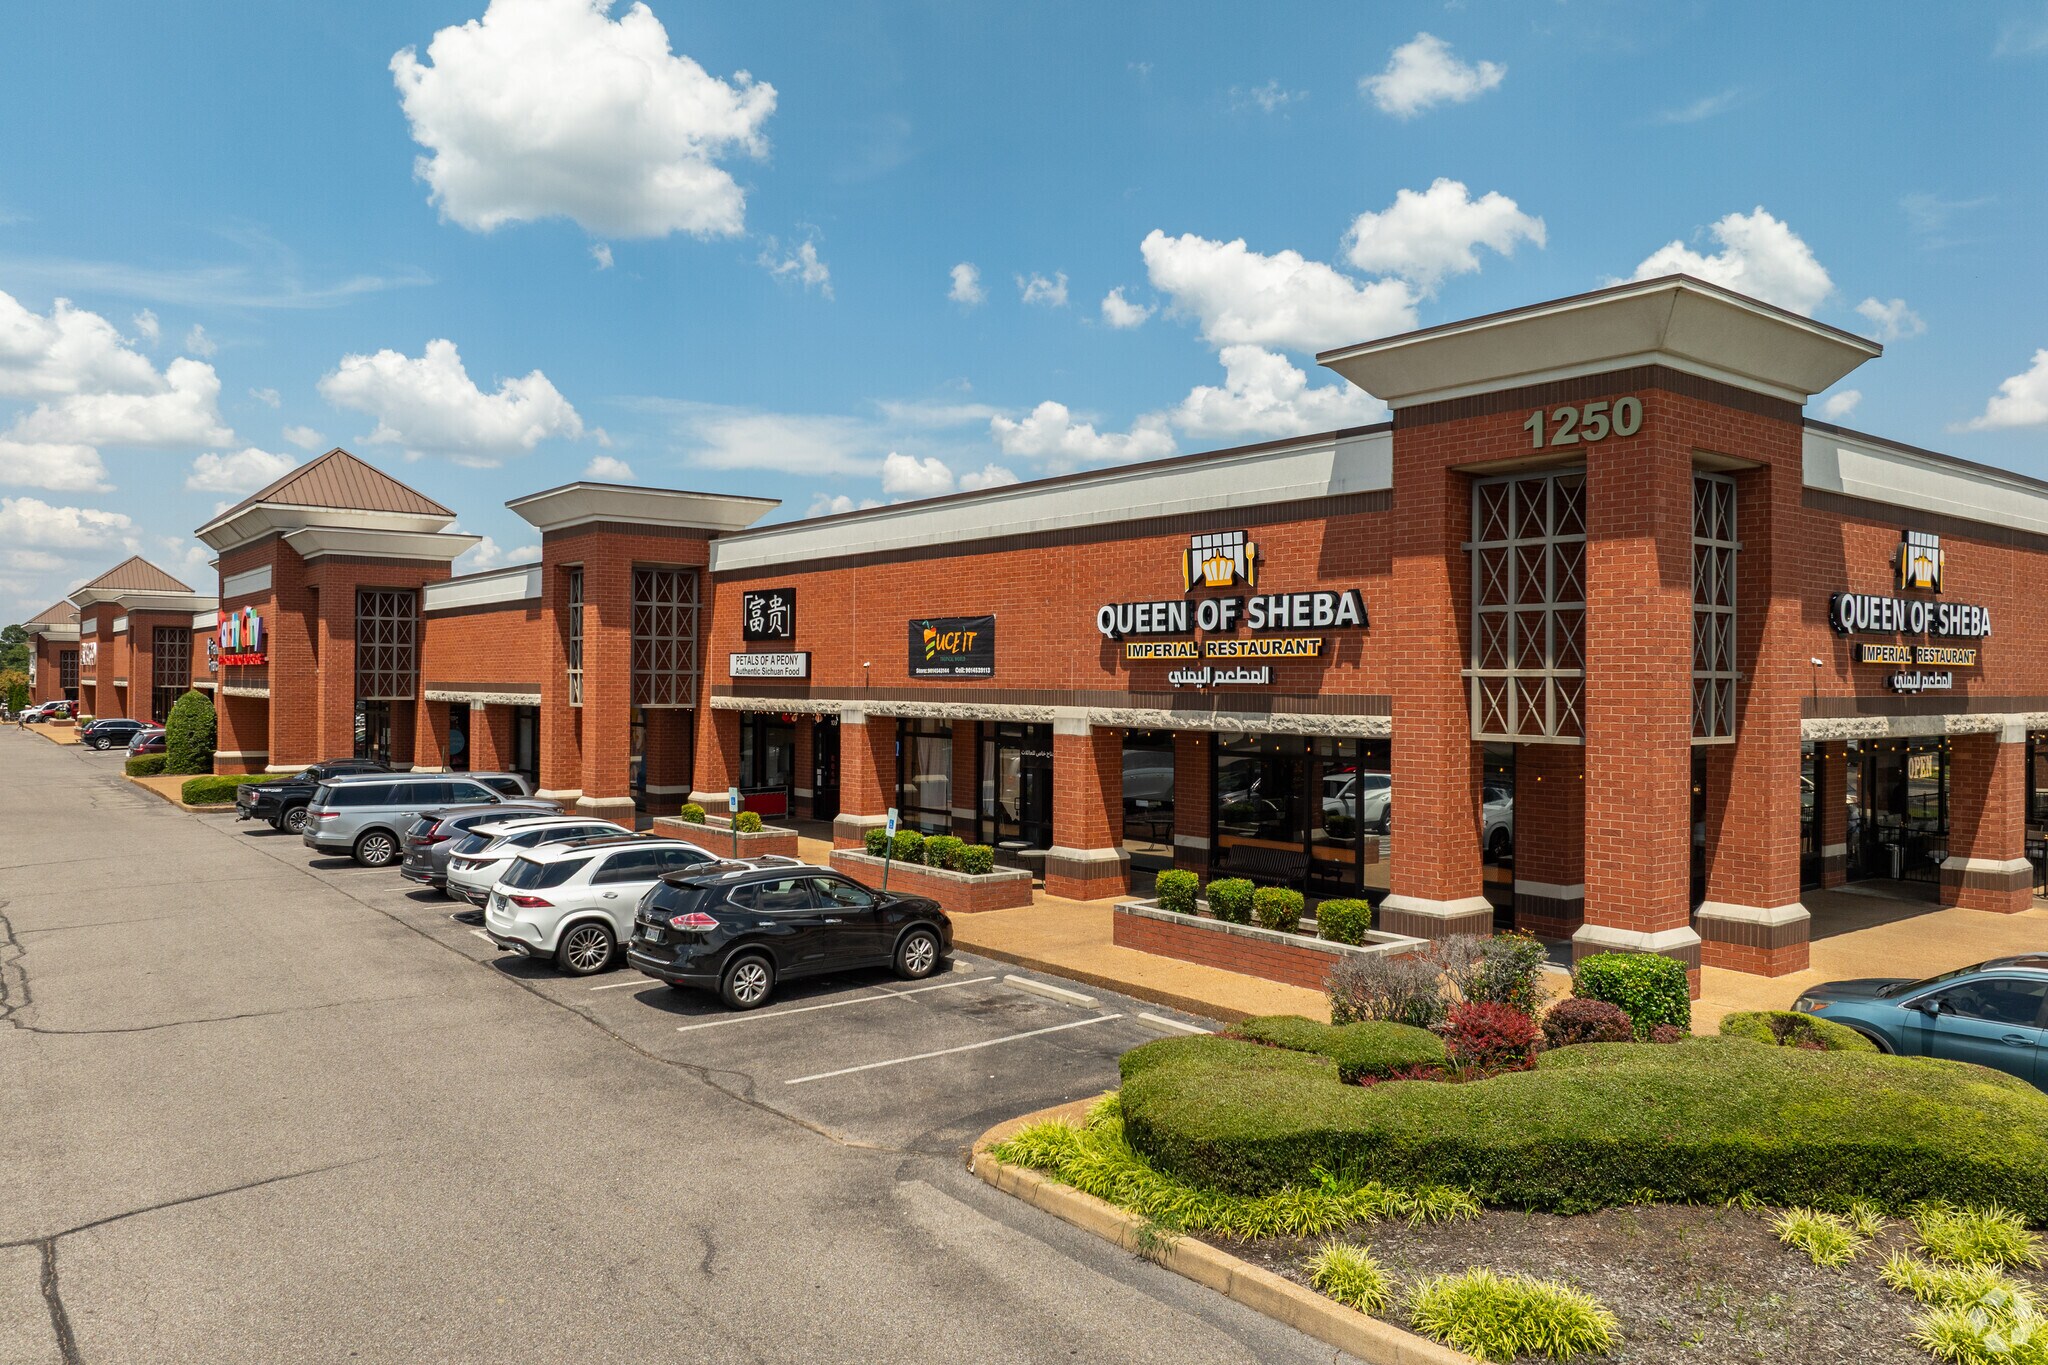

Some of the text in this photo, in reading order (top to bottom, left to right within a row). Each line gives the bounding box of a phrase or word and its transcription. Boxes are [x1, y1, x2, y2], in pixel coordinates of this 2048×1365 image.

[1523, 396, 1643, 449] 1250
[1097, 591, 1360, 639] QUEEN OF SHEBA
[1840, 593, 1992, 636] QUEEN OF SHEBA
[1127, 639, 1320, 658] IMPERIAL RESTAURANT
[1863, 644, 1976, 665] IMPERIAL RESTAURANT
[735, 654, 799, 666] PETALS OF A PEONY
[735, 666, 800, 676] Authentic Sichuan Food
[1168, 666, 1269, 688] المطعم اليمني
[1908, 755, 1933, 779] OPEN
